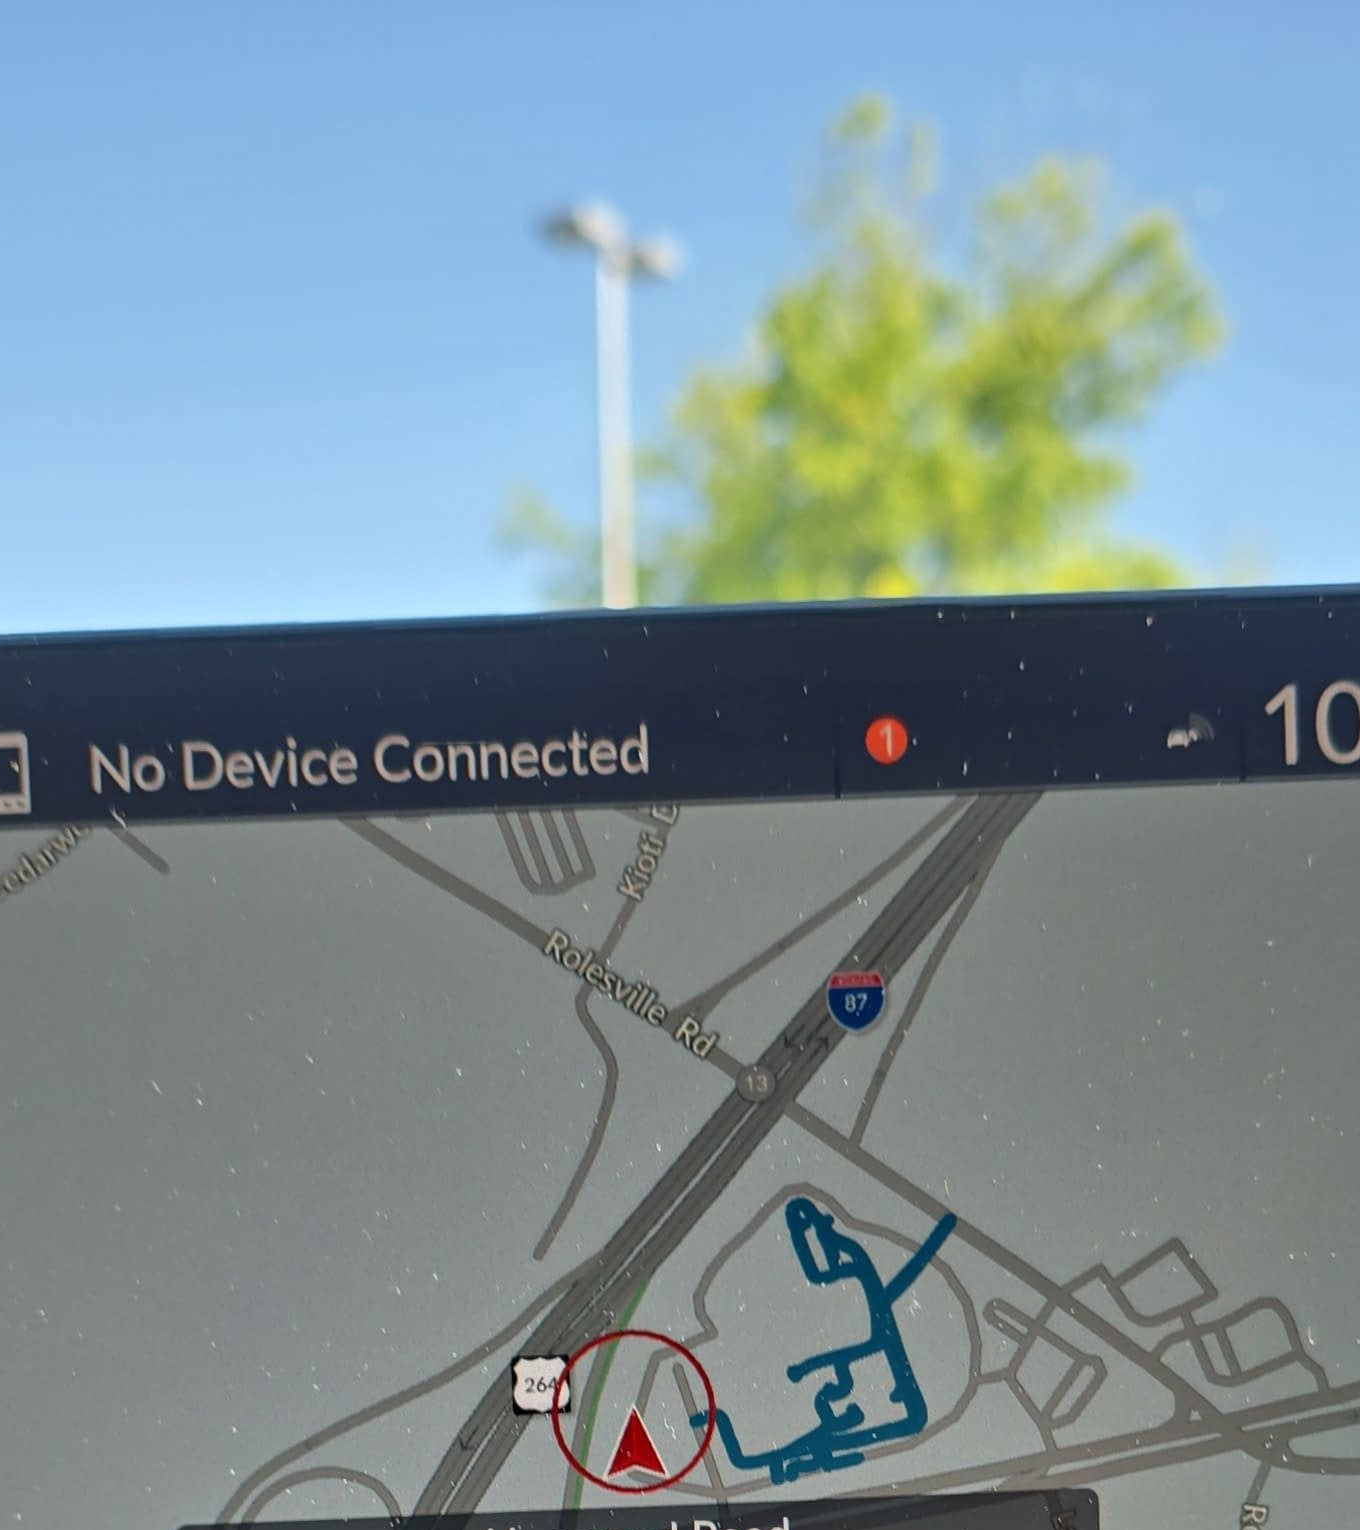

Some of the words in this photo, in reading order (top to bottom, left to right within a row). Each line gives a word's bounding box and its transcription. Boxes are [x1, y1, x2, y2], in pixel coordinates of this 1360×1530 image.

[879, 724, 892, 757] 1
[90, 744, 166, 794] No
[182, 737, 358, 791] Device
[374, 723, 649, 783] Connected
[618, 832, 664, 901] Kioti
[544, 930, 666, 1026] Rolesville
[675, 1016, 718, 1058] Rd
[844, 992, 868, 1013] 87
[745, 1074, 769, 1093] 13
[524, 1376, 559, 1394] 264
